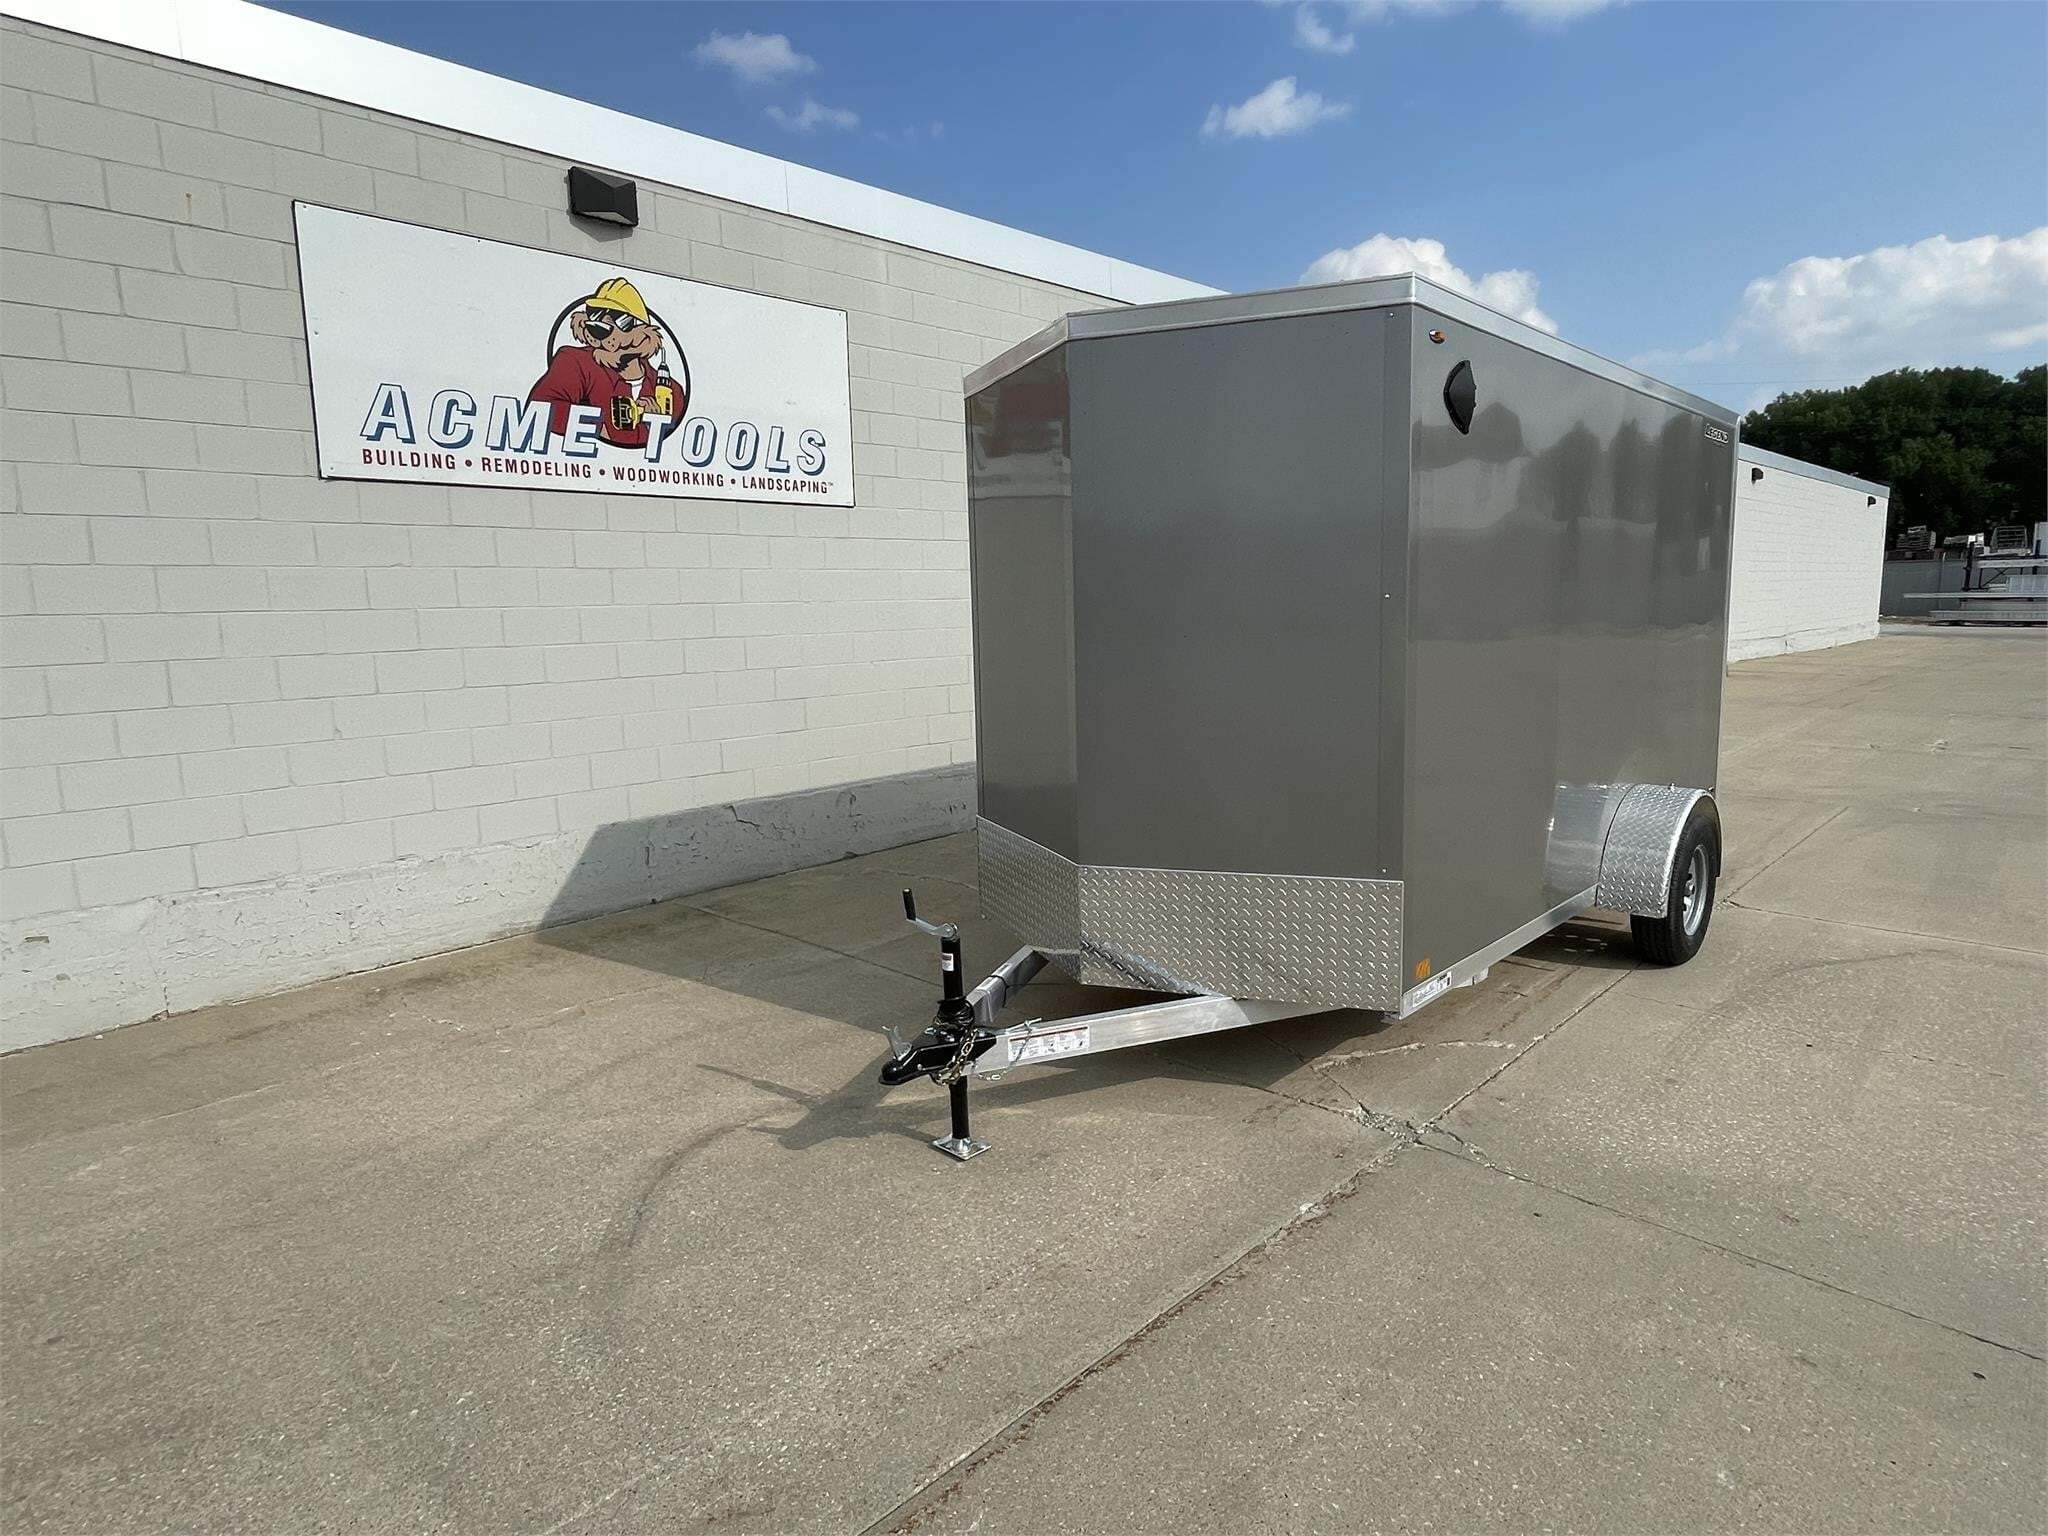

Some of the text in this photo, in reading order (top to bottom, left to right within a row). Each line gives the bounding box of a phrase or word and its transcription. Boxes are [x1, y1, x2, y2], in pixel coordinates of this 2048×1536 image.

[360, 383, 826, 475] ACME TOOLS
[362, 448, 456, 470] BUILDING
[482, 457, 592, 478] REMODELING
[613, 466, 724, 487] WOODWORKING
